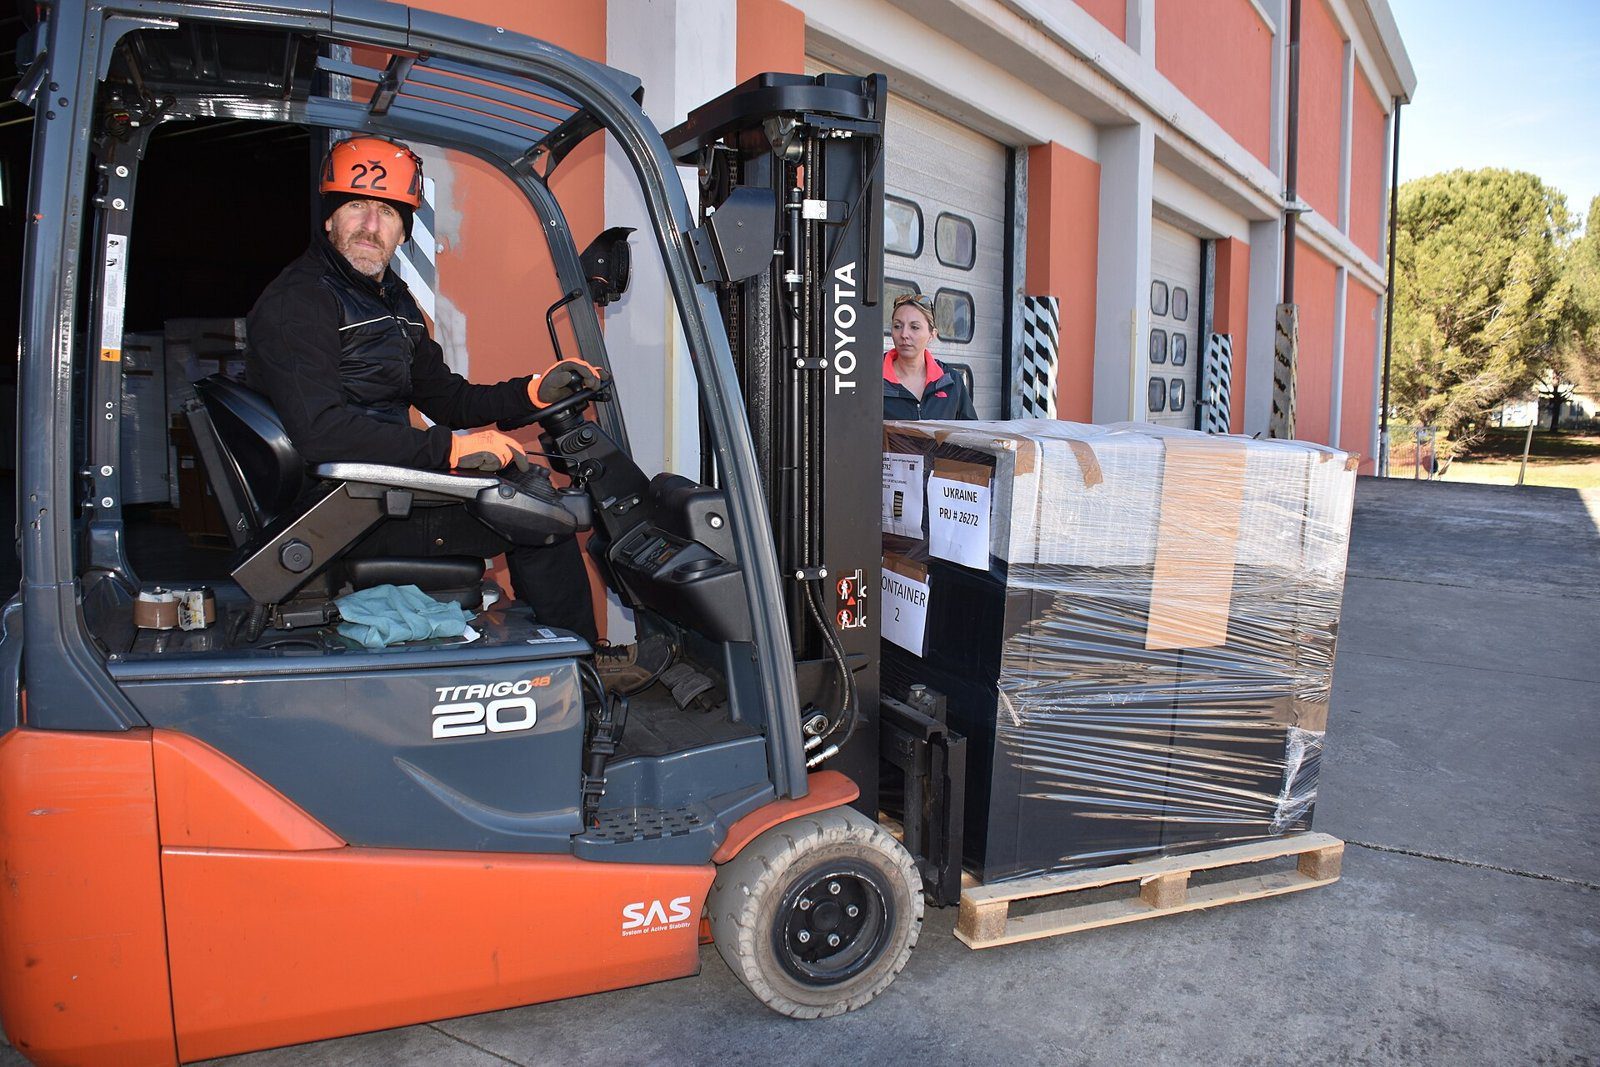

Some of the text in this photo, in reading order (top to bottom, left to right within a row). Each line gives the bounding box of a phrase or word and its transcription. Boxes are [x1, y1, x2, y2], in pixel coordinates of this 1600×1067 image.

[350, 163, 387, 191] 22
[833, 261, 857, 395] TOYOTA
[943, 486, 978, 503] UKRAINE
[939, 507, 979, 527] PRJ # 26272
[880, 575, 926, 608] ONTAINER
[894, 607, 900, 623] 2
[431, 697, 538, 739] 20
[622, 896, 691, 930] SAS
[622, 929, 643, 937] System
[669, 922, 691, 930] Stability
